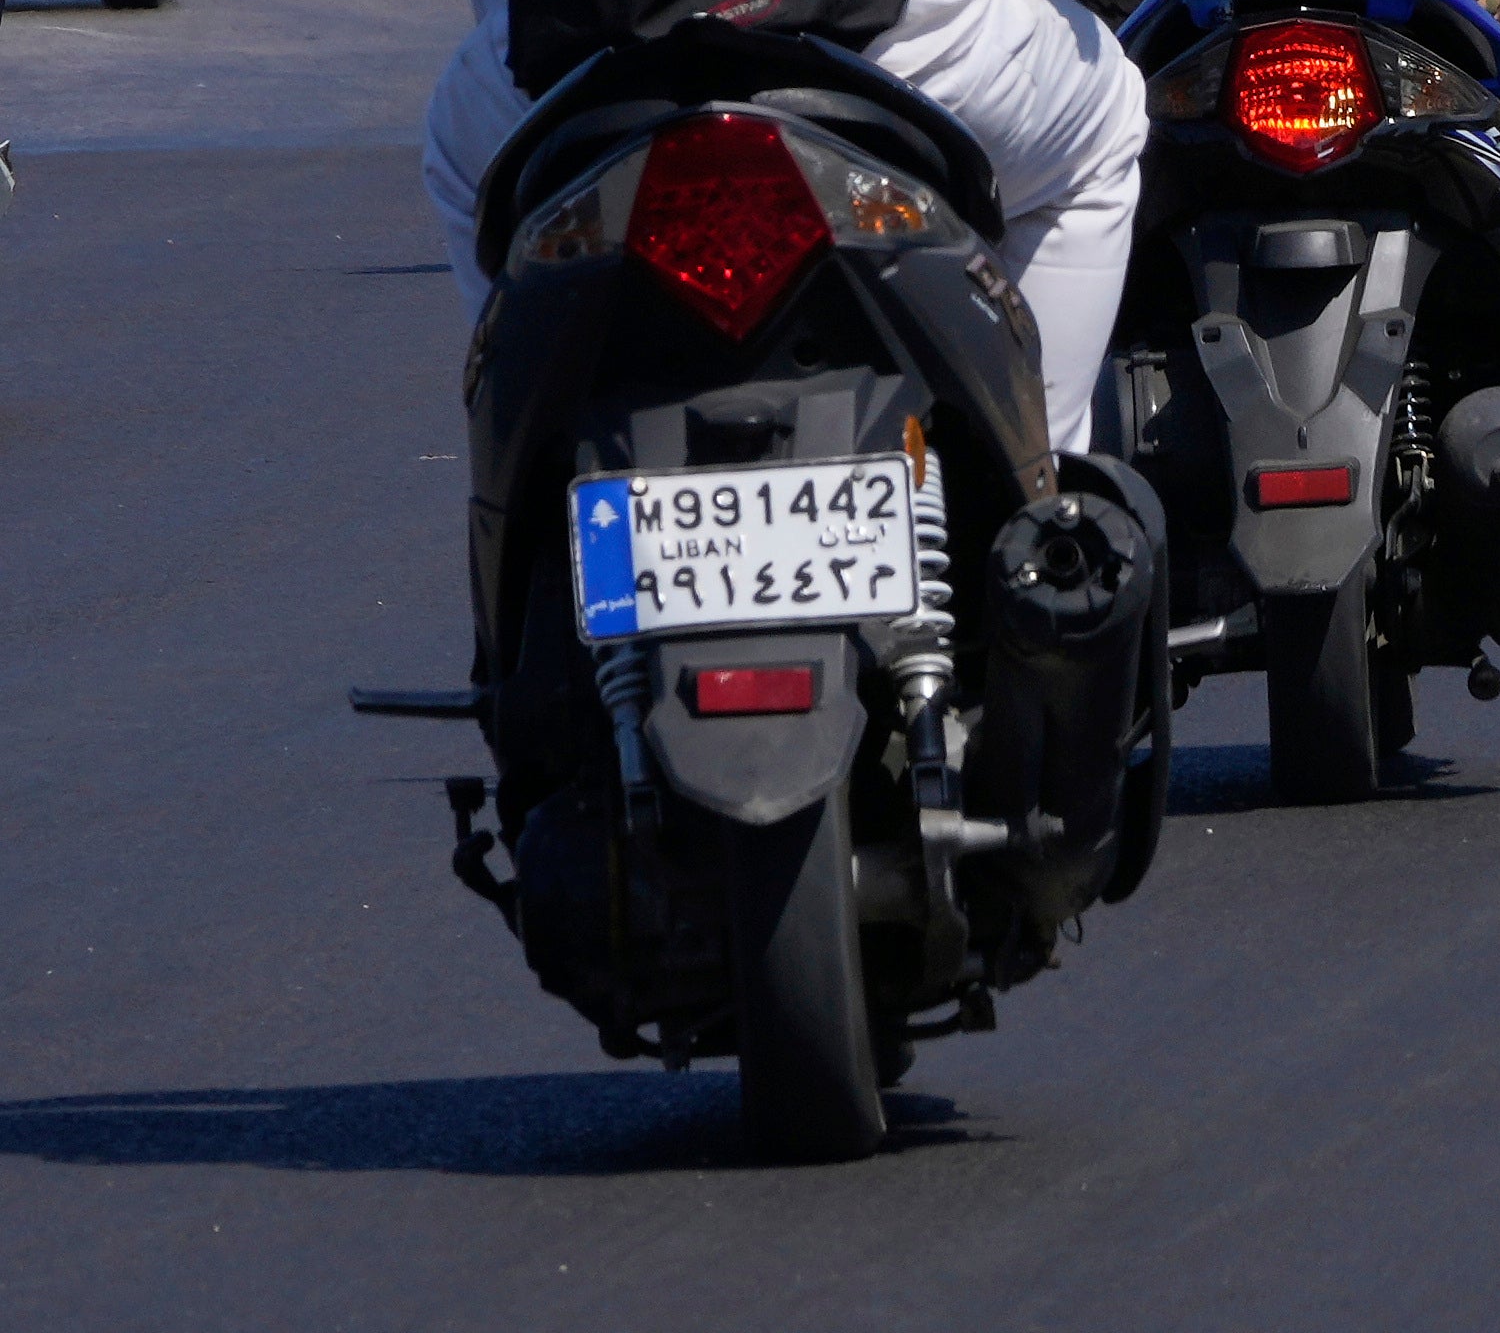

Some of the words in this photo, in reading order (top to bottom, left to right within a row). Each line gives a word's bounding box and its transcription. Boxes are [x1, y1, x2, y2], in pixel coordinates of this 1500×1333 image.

[634, 474, 898, 534] M991442
[660, 534, 744, 561] LIBAN
[818, 523, 888, 554] لبنان
